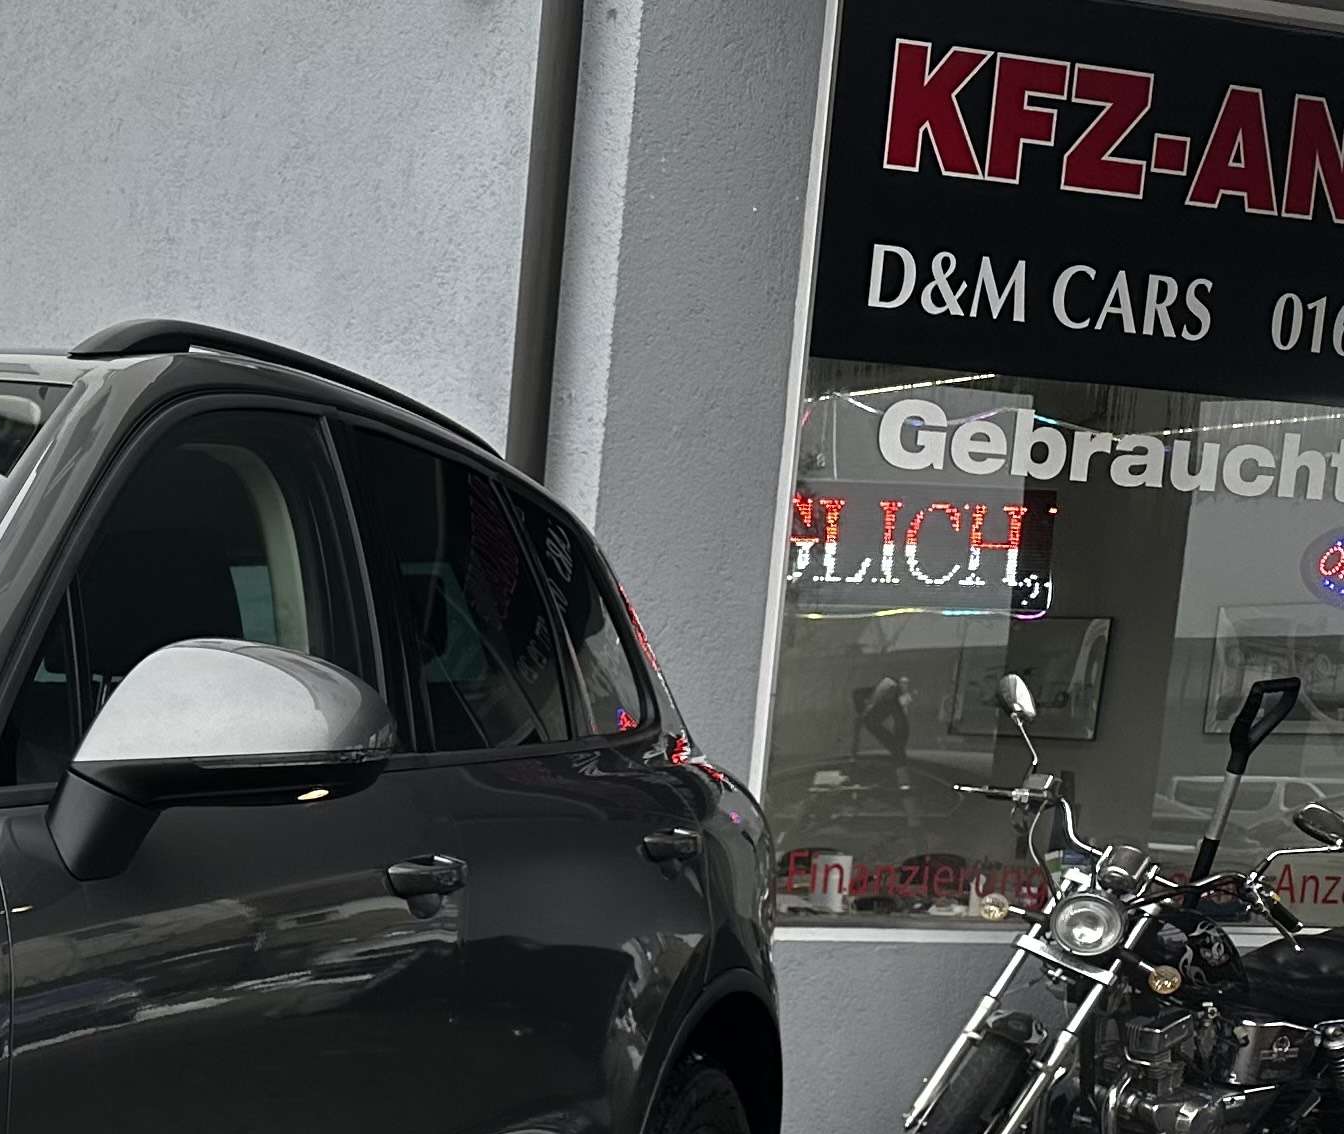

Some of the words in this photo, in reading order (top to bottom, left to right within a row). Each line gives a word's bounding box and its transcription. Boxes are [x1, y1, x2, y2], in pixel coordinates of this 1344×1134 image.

[867, 243, 1026, 324] D&M
[1052, 264, 1214, 341] CARS
[1276, 863, 1344, 906] Anz
